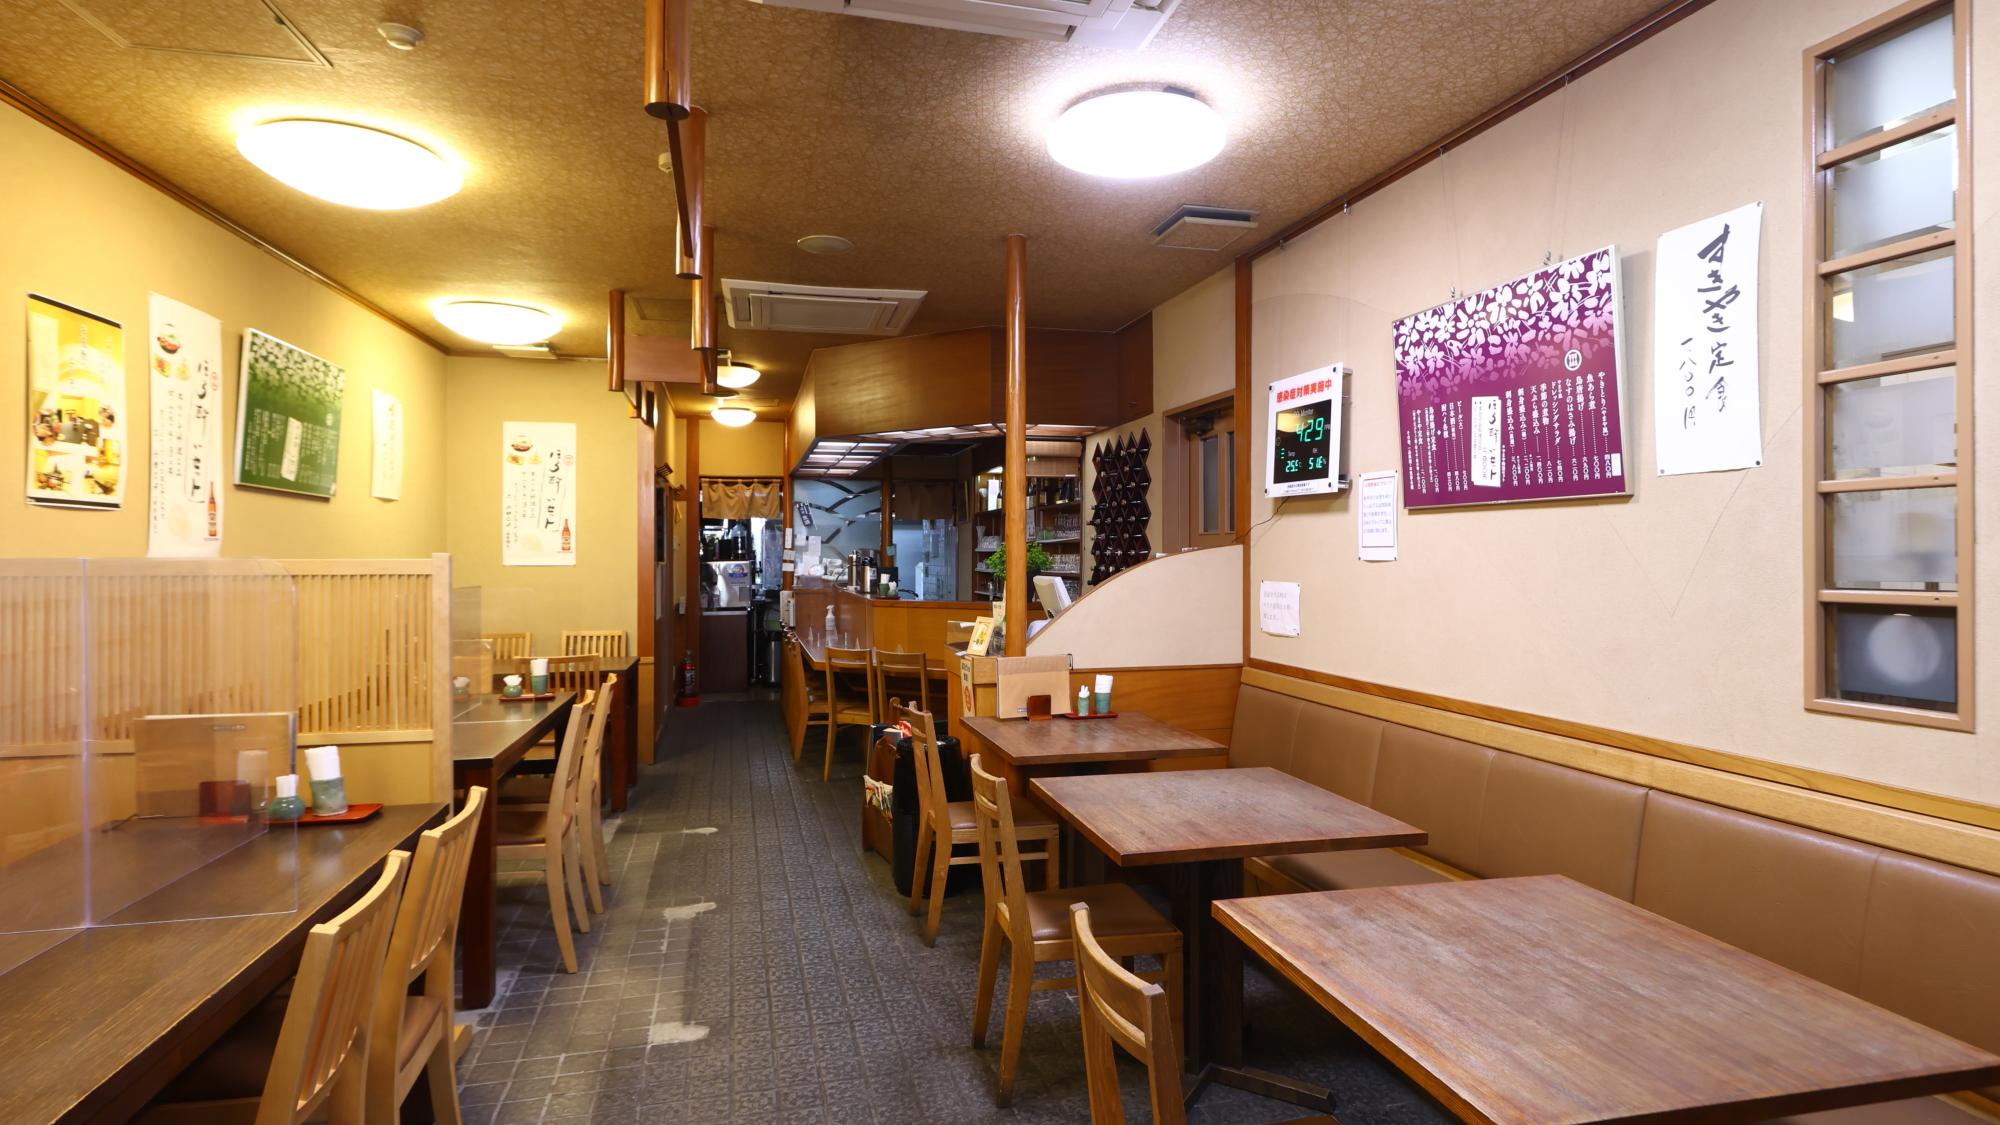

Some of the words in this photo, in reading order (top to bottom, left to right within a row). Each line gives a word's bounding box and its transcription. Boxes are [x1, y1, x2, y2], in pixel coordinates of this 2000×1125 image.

[1697, 223, 1741, 412] すきやき定食
[1276, 379, 1333, 404] 感染症対策実施中
[1296, 417, 1324, 442] 429
